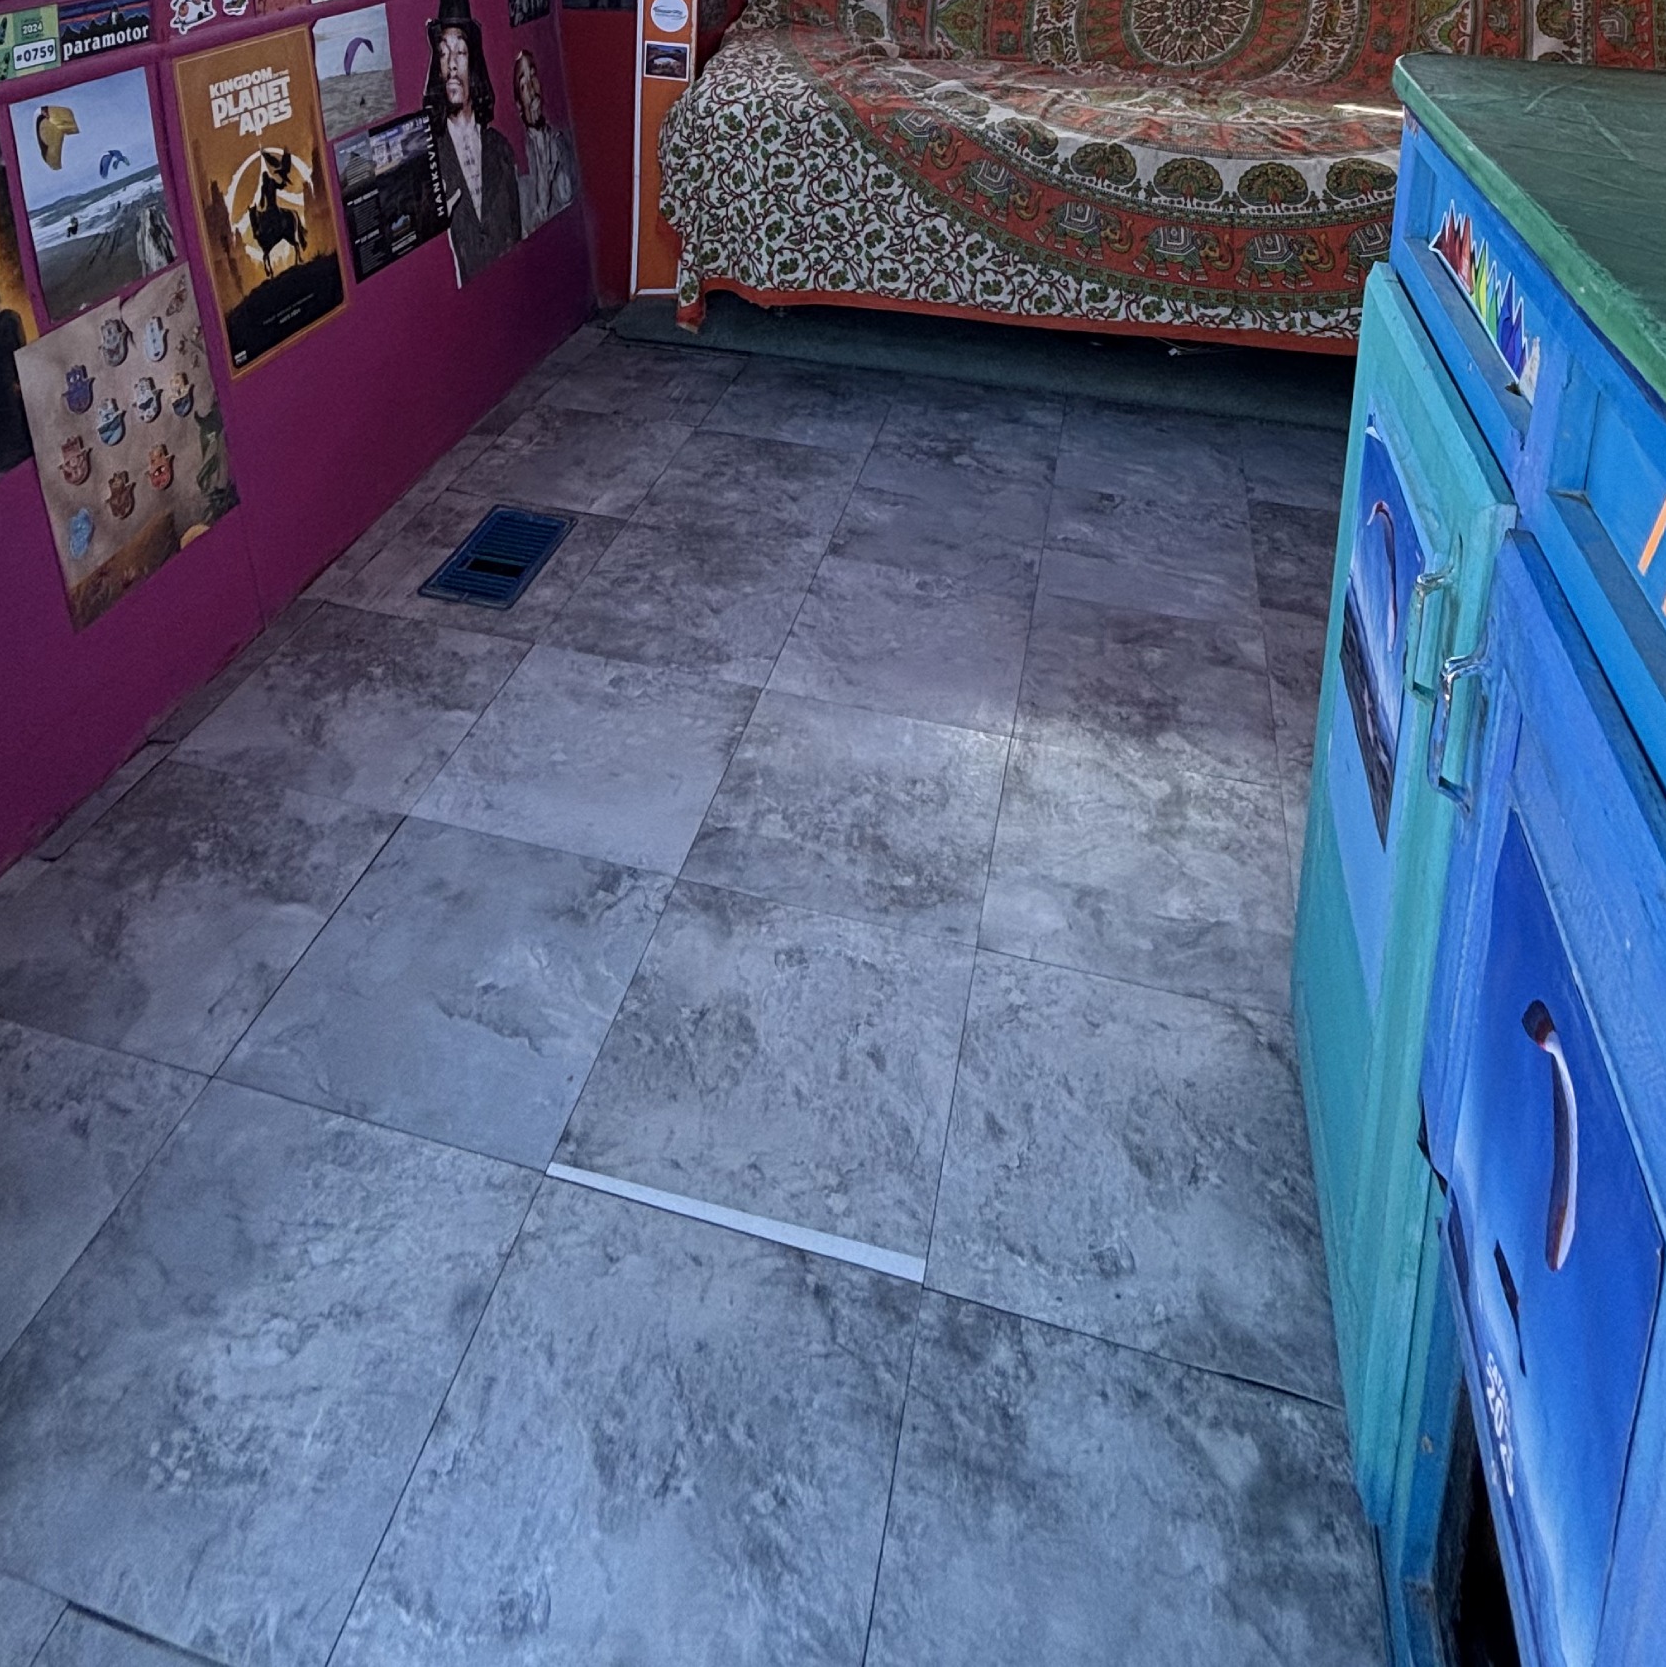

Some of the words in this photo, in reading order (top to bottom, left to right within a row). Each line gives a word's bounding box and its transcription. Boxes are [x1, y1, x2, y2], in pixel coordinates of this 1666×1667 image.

[22, 21, 43, 35] 2024
[62, 24, 149, 61] paramotor
[16, 44, 55, 62] #0759
[209, 66, 273, 99] KINGDOM
[211, 75, 291, 129] PLANET
[239, 97, 293, 137] APES
[422, 114, 445, 217] HANKSVILLE
